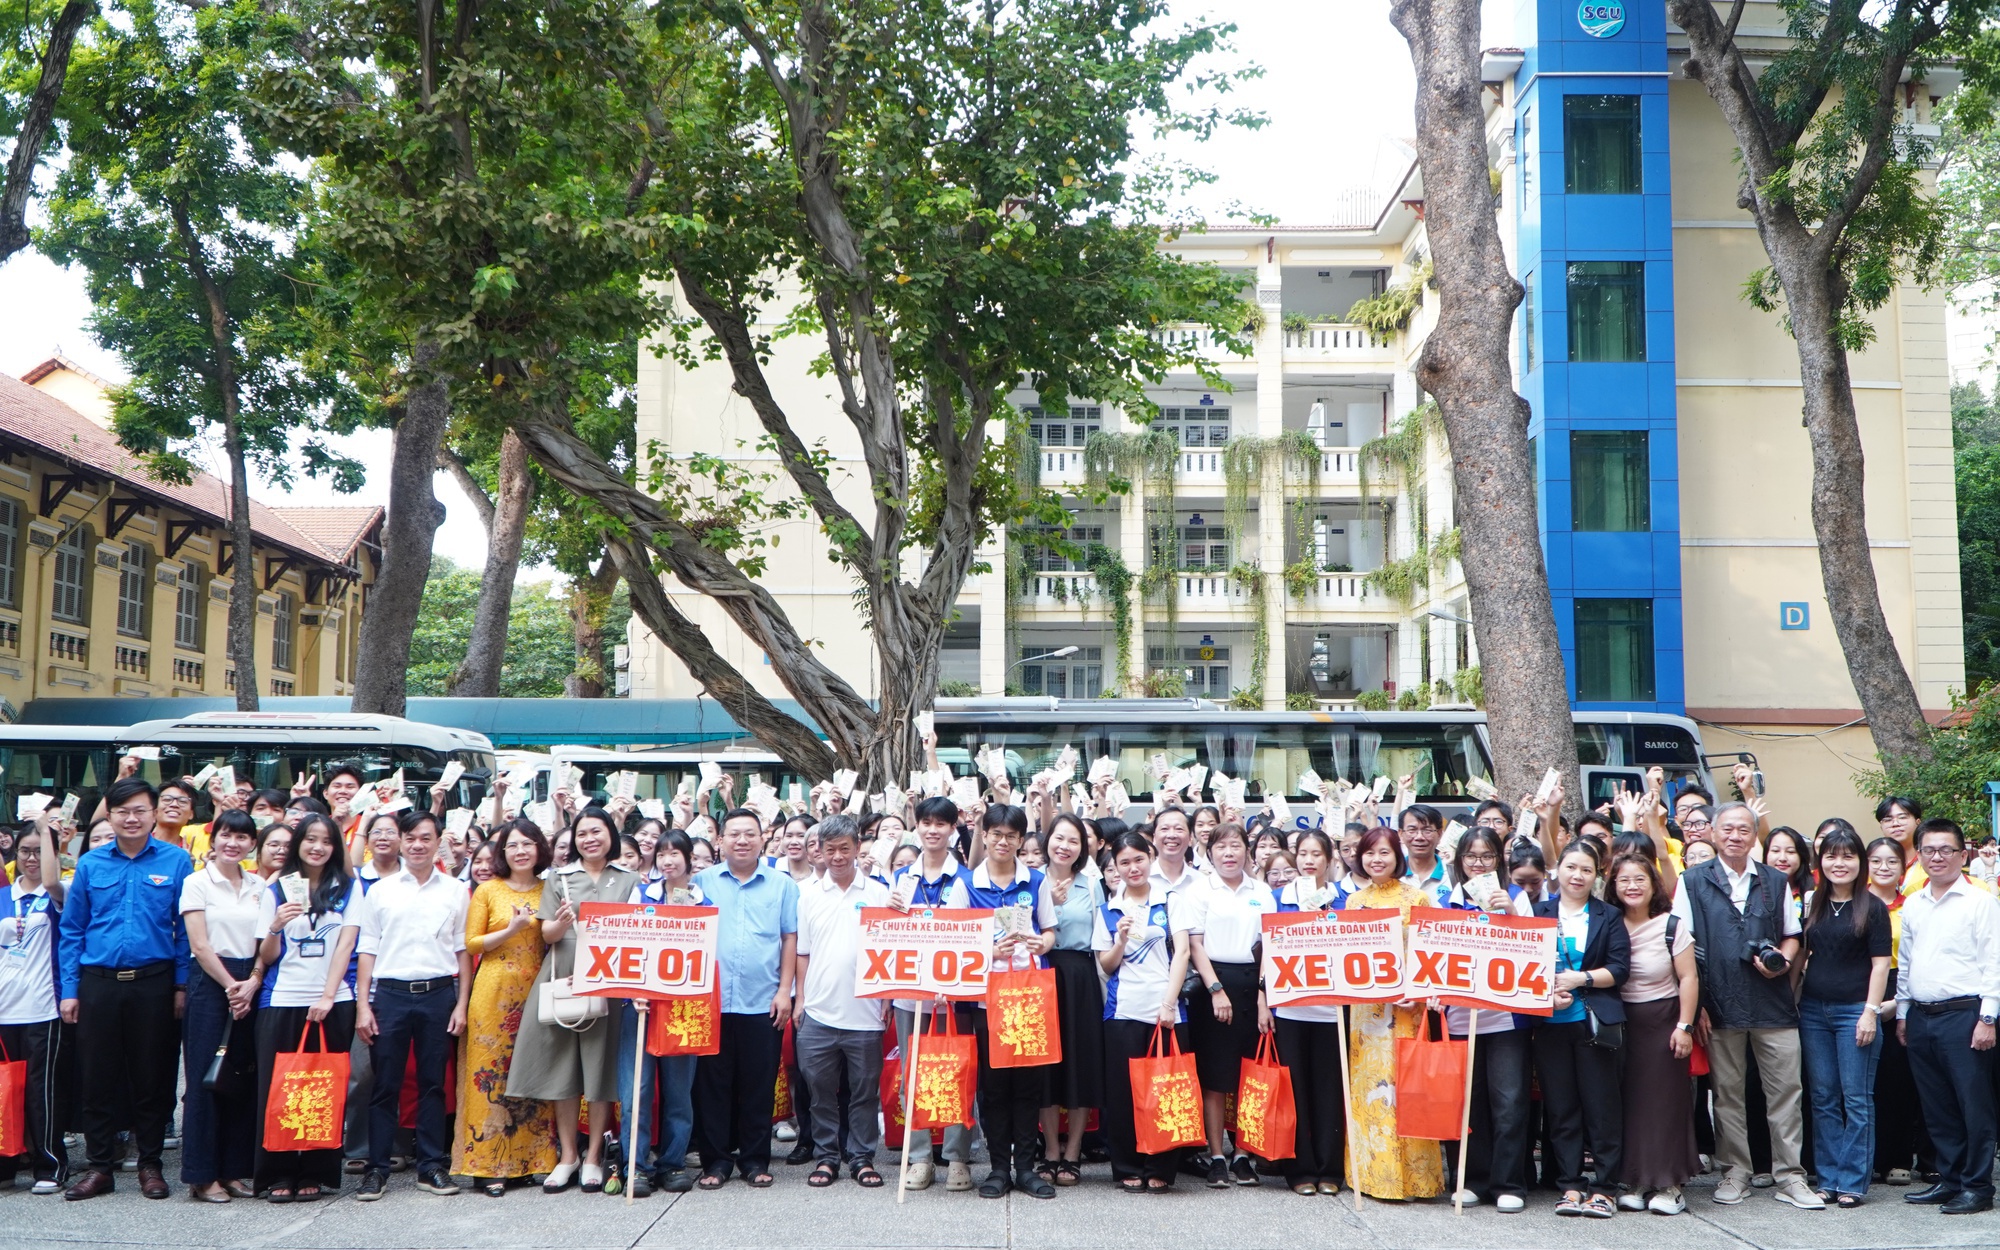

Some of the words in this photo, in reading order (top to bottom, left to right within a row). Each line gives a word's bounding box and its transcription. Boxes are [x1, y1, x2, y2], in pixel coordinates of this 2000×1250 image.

[1583, 6, 1621, 19] SGU
[1786, 608, 1804, 626] D
[602, 914, 639, 927] CHUYẾN
[641, 919, 653, 928] XE
[655, 917, 681, 929] ĐOÀN
[684, 918, 705, 930] VIÊN
[882, 918, 917, 930] CHUYẾN
[920, 922, 931, 930] XE
[933, 920, 958, 931] ĐOÀN
[961, 921, 982, 931] VIÊN
[1286, 922, 1322, 936] CHUYẾN
[1325, 925, 1337, 934] XE
[1339, 922, 1365, 933] ĐOÀN
[1368, 920, 1389, 932] VIÊN
[1434, 921, 1472, 935] CHUYẾN
[1475, 926, 1487, 936] XE
[1490, 926, 1517, 939] ĐOÀN
[1520, 929, 1543, 942] VIÊN
[586, 946, 644, 980] XE
[658, 948, 703, 984] 01
[863, 949, 918, 981] XE
[932, 950, 985, 983] 02
[1272, 955, 1330, 988] XE
[1344, 952, 1398, 986] 03
[1412, 950, 1472, 988] XE
[1488, 958, 1548, 996] 04
